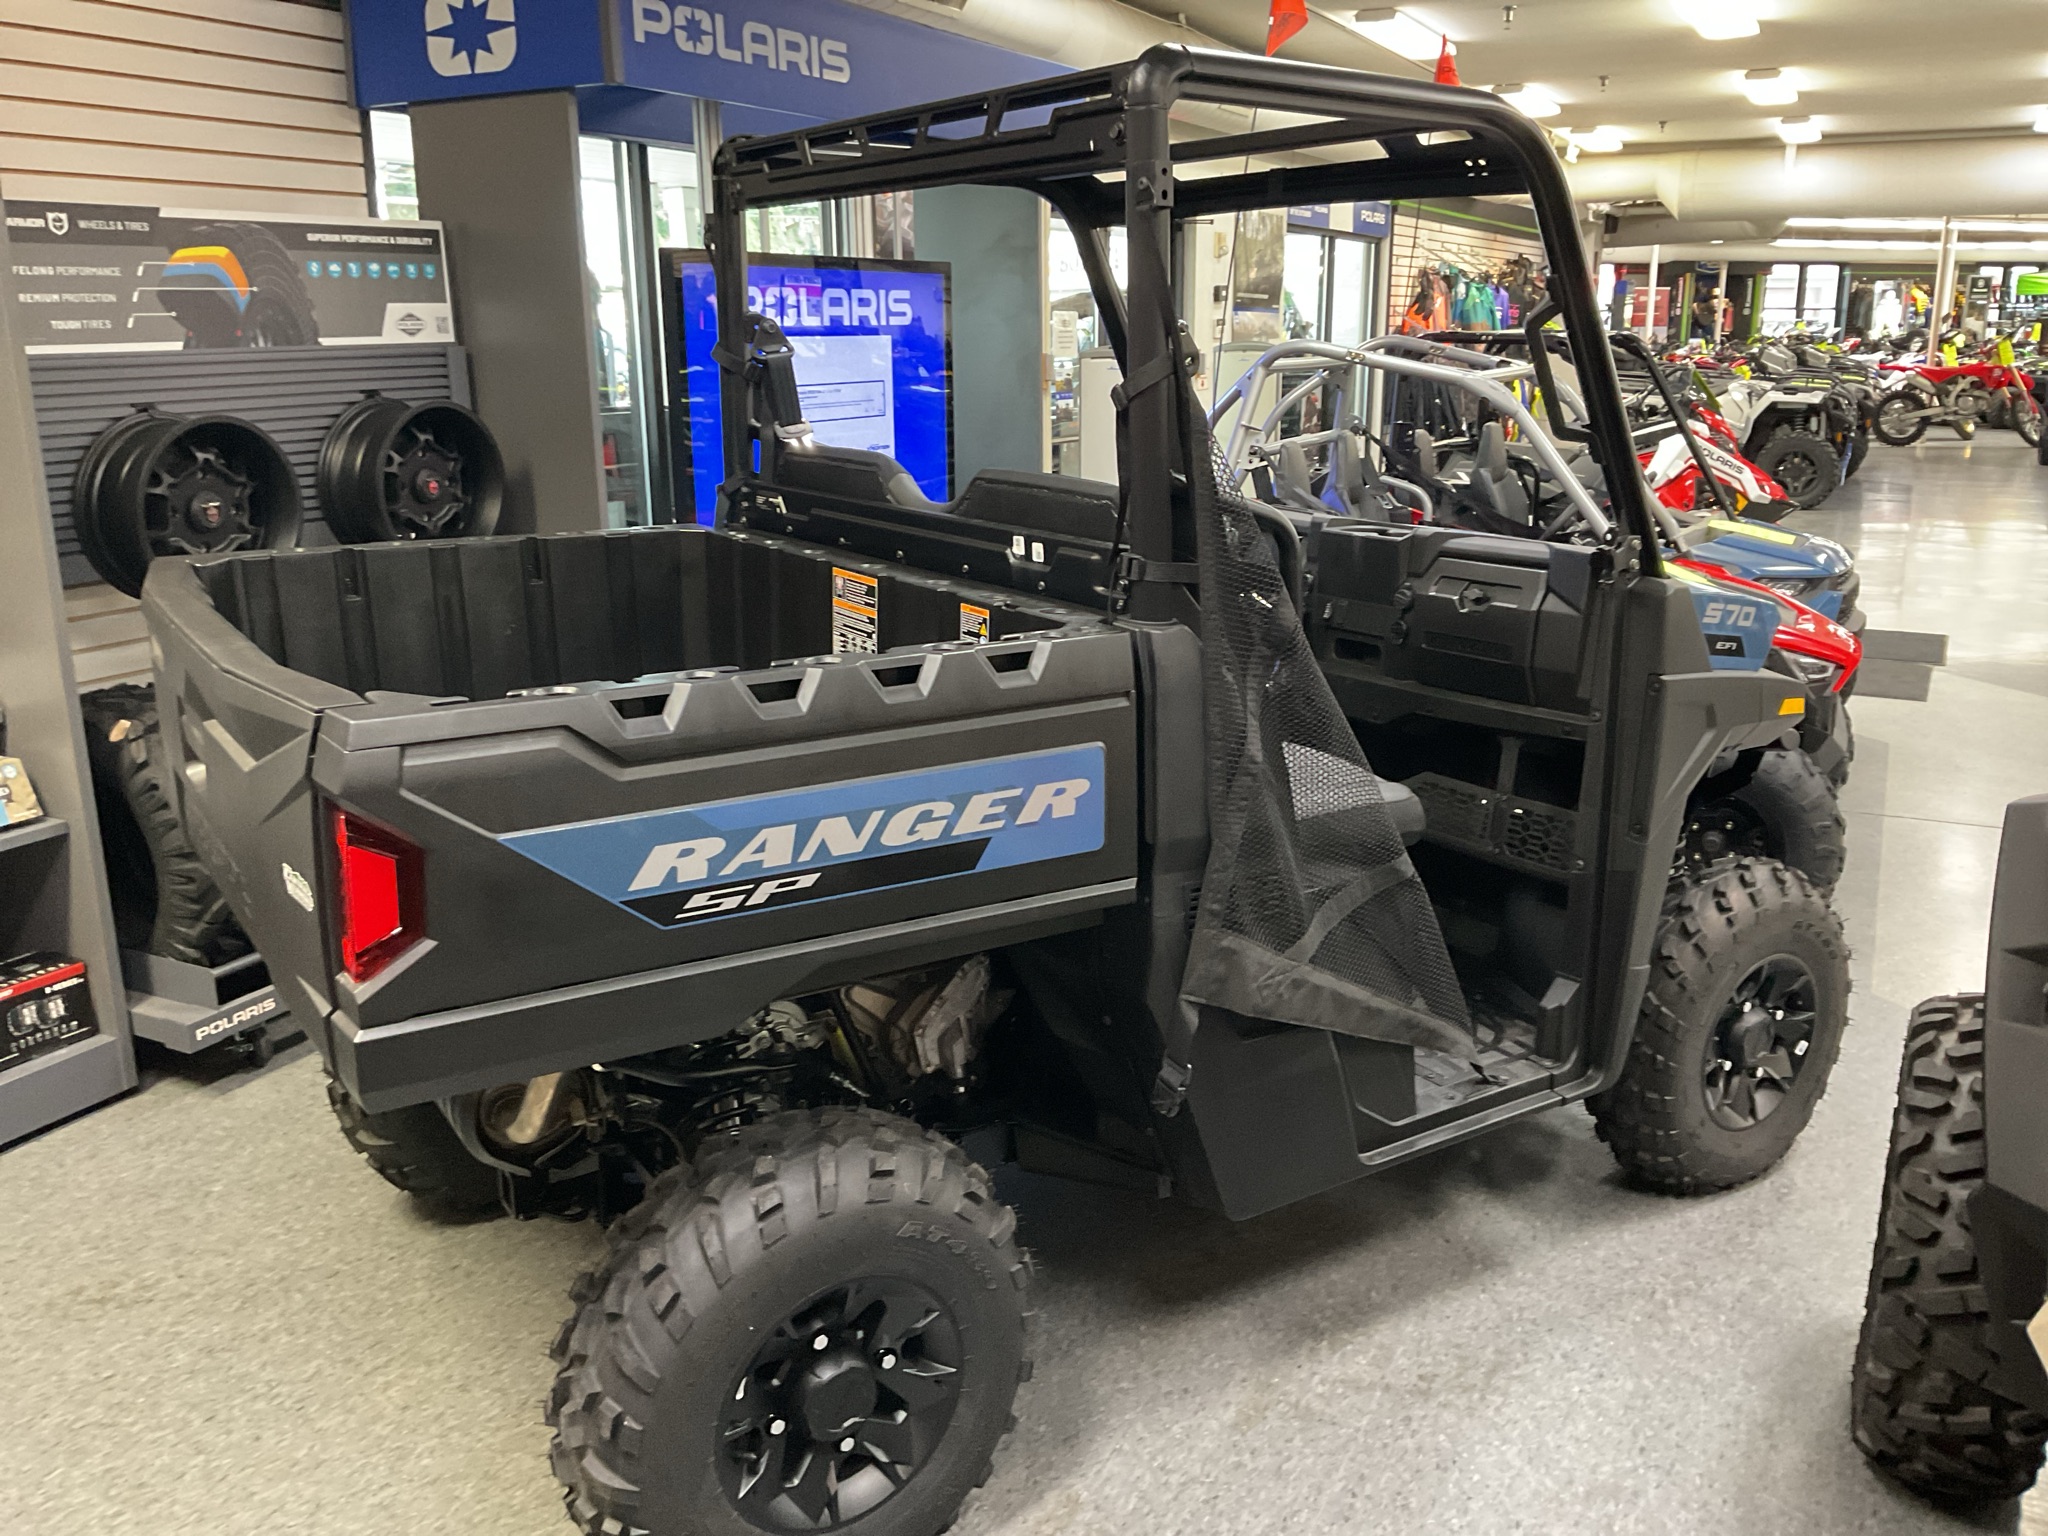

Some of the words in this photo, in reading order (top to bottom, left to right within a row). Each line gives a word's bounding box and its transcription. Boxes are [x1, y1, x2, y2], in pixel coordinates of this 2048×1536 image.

[632, 0, 851, 84] POLARIS
[124, 221, 150, 232] TIRES
[1361, 209, 1386, 225] POLARIS
[55, 266, 122, 277] PERFORMANCE
[60, 293, 117, 303] PROTECTION
[82, 319, 112, 330] TIRES
[1701, 446, 1745, 475] OLARIS
[627, 778, 1092, 892] RANGER
[674, 872, 823, 919] SP
[195, 997, 277, 1041] POLARIS
